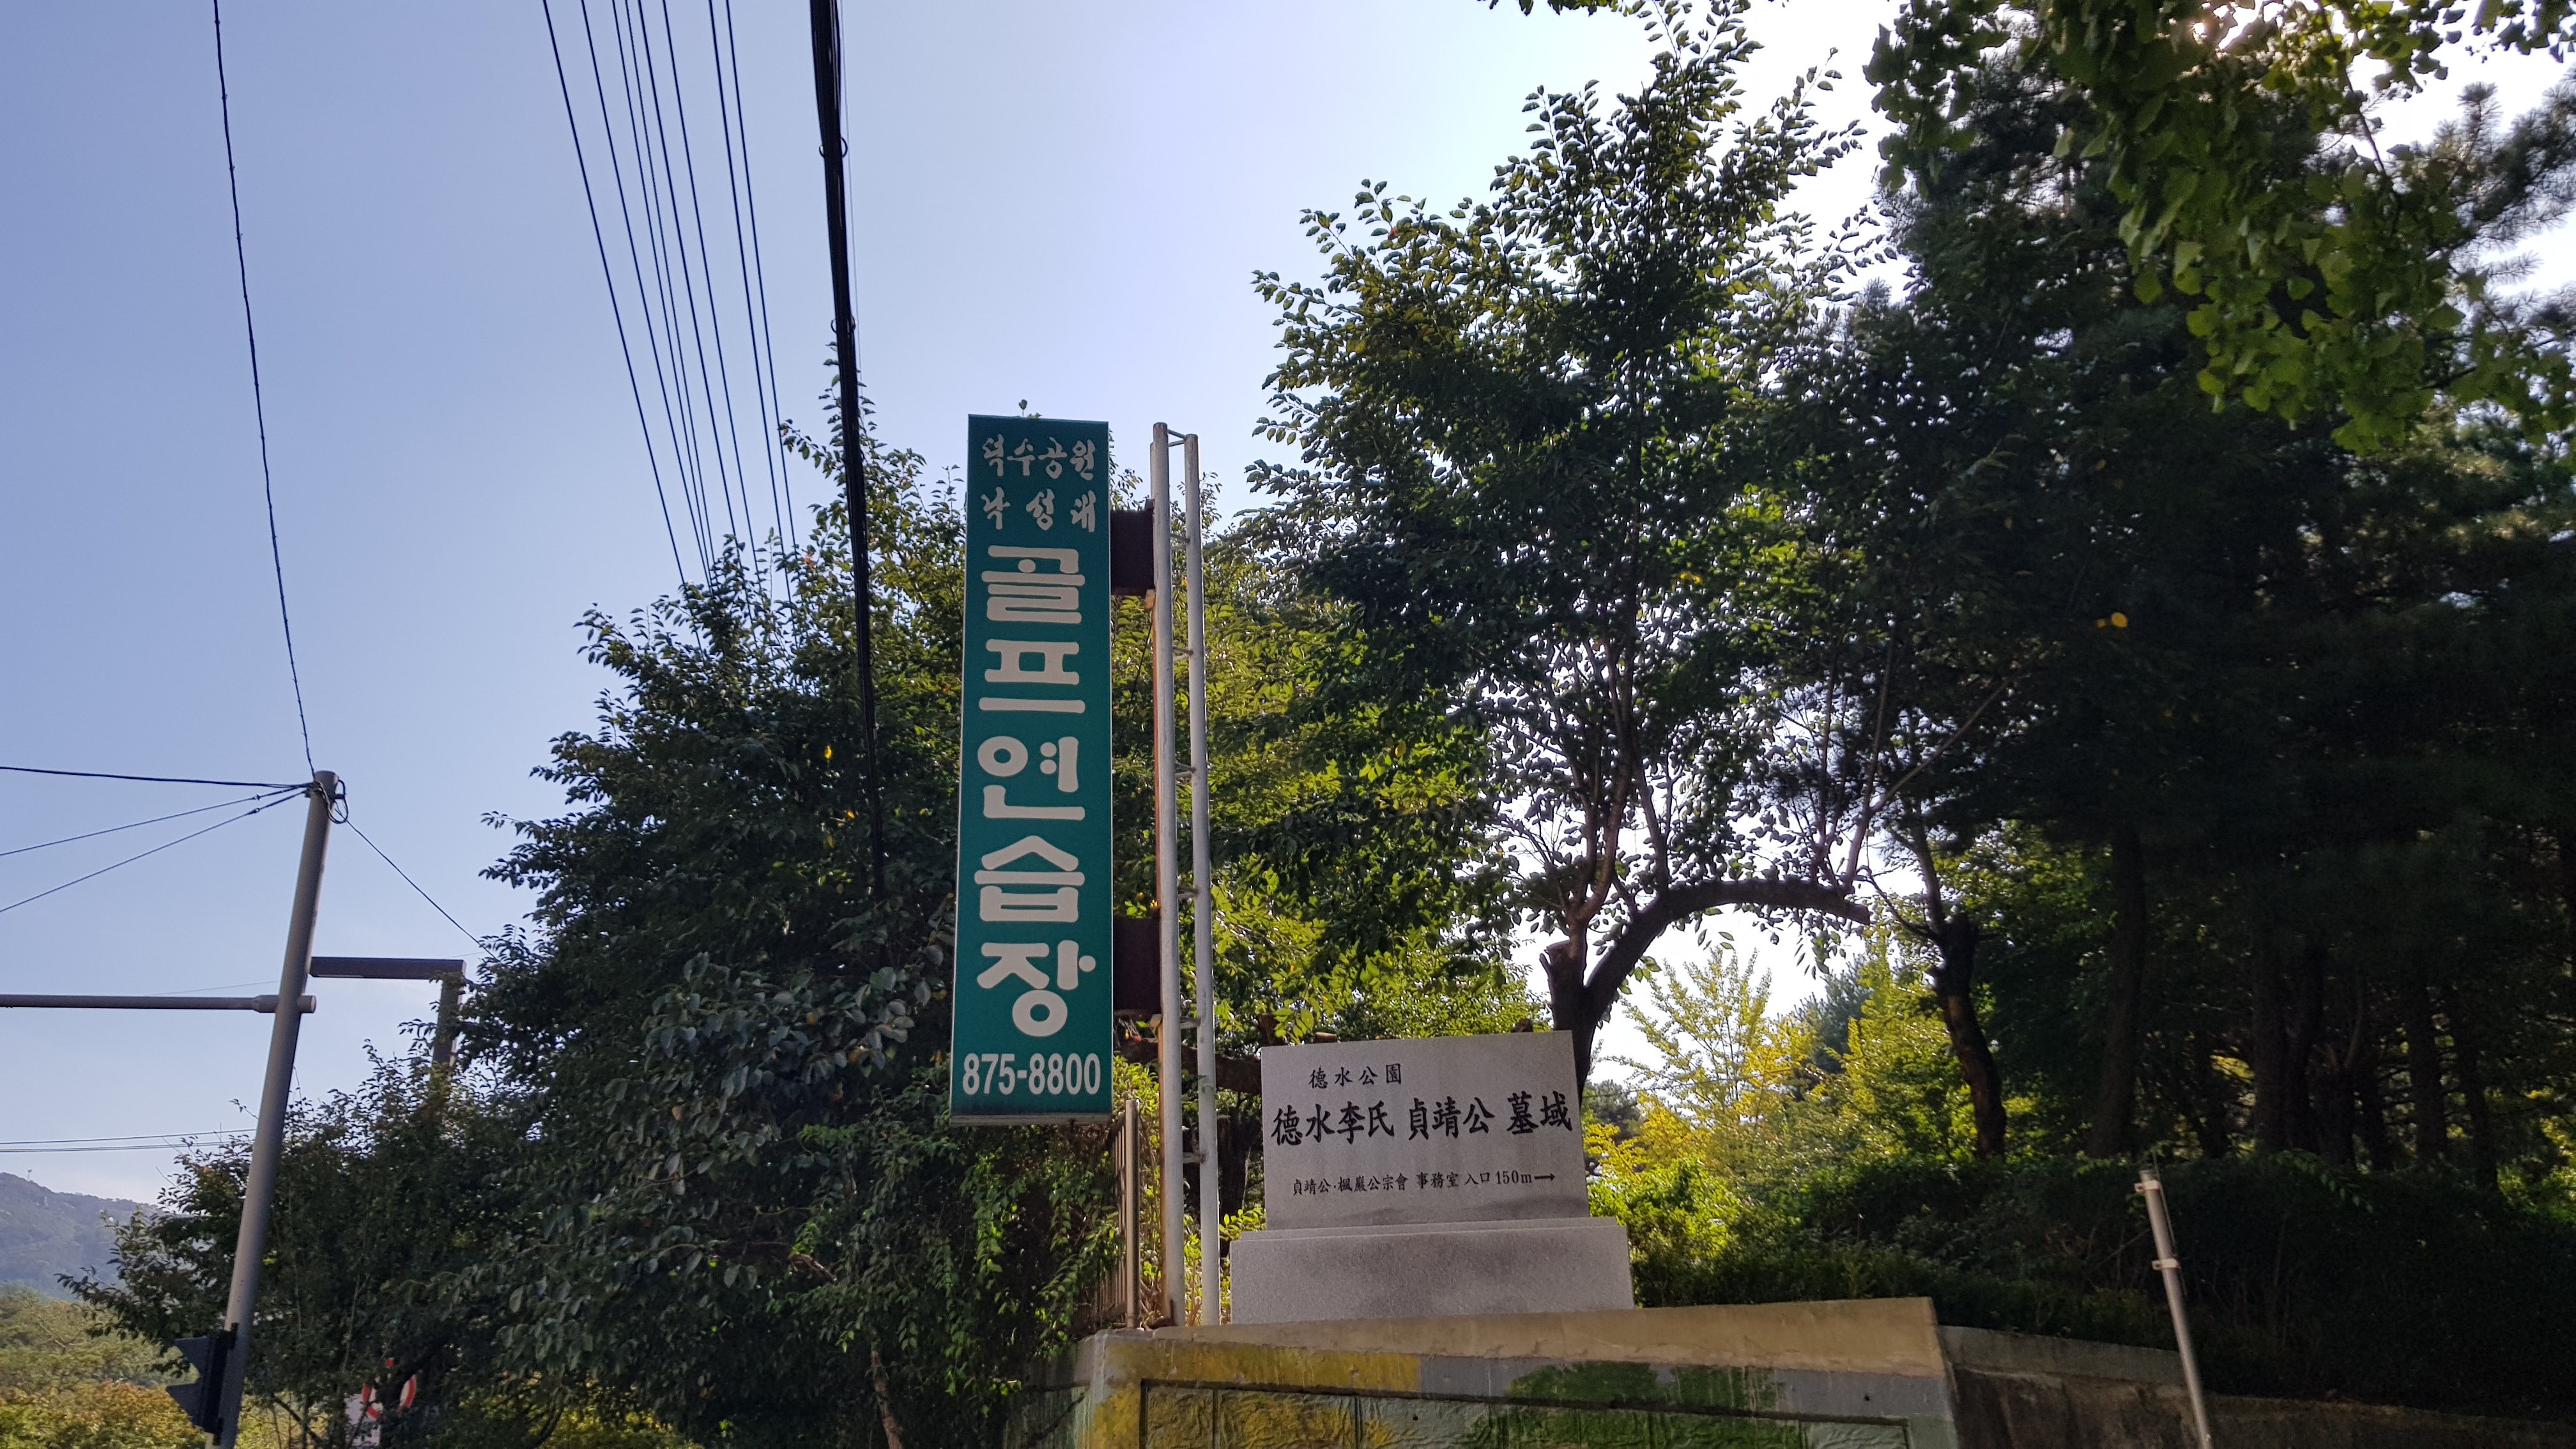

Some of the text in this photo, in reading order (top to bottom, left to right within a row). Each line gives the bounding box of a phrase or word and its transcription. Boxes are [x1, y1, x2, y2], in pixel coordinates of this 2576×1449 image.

[982, 433, 1096, 480] 덕수공원
[974, 545, 1096, 1037] 골프연습장
[962, 1053, 1101, 1095] 875-8800
[1308, 1063, 1402, 1089] 德水公園
[1271, 1091, 1574, 1146] 德水李氏 貞靖公 墓域
[1416, 1172, 1459, 1189] 事務室
[1464, 1171, 1491, 1186] 入口
[1496, 1170, 1532, 1184] 150m
